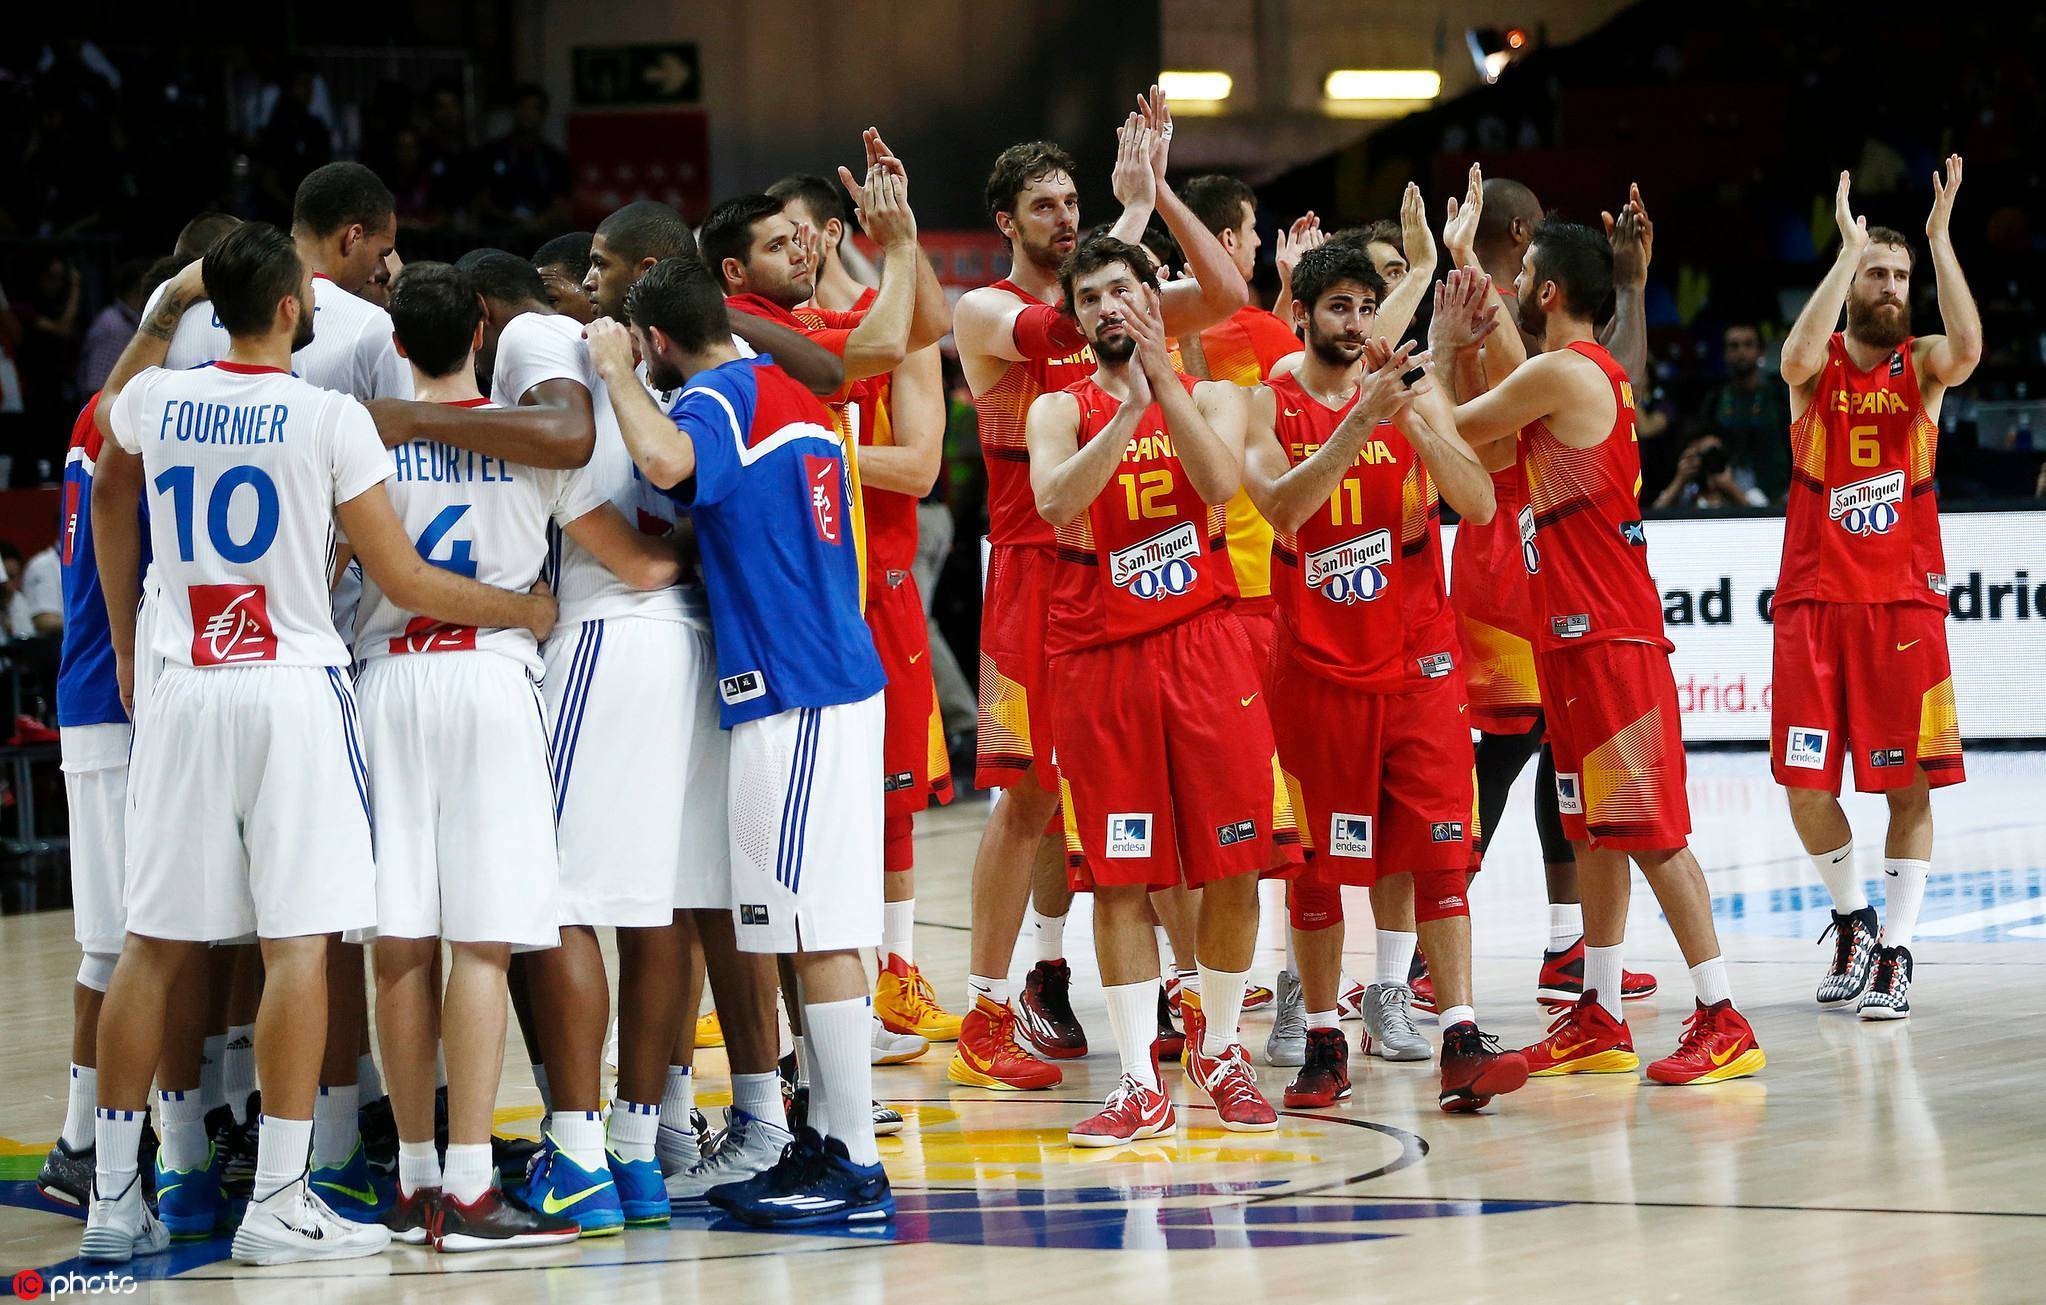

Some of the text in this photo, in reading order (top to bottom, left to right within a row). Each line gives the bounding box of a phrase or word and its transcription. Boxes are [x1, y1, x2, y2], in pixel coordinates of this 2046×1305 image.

[160, 400, 289, 445] FOURNIER
[1831, 387, 1909, 414] ESPAÑA
[1122, 429, 1178, 463] PAÑ
[1850, 425, 1881, 468] 6
[154, 465, 280, 564] 10
[1118, 469, 1178, 521] 12
[1330, 478, 1363, 526] 11
[415, 504, 478, 579] 4
[1112, 842, 1146, 852] endesa
[1335, 842, 1367, 852] endesa
